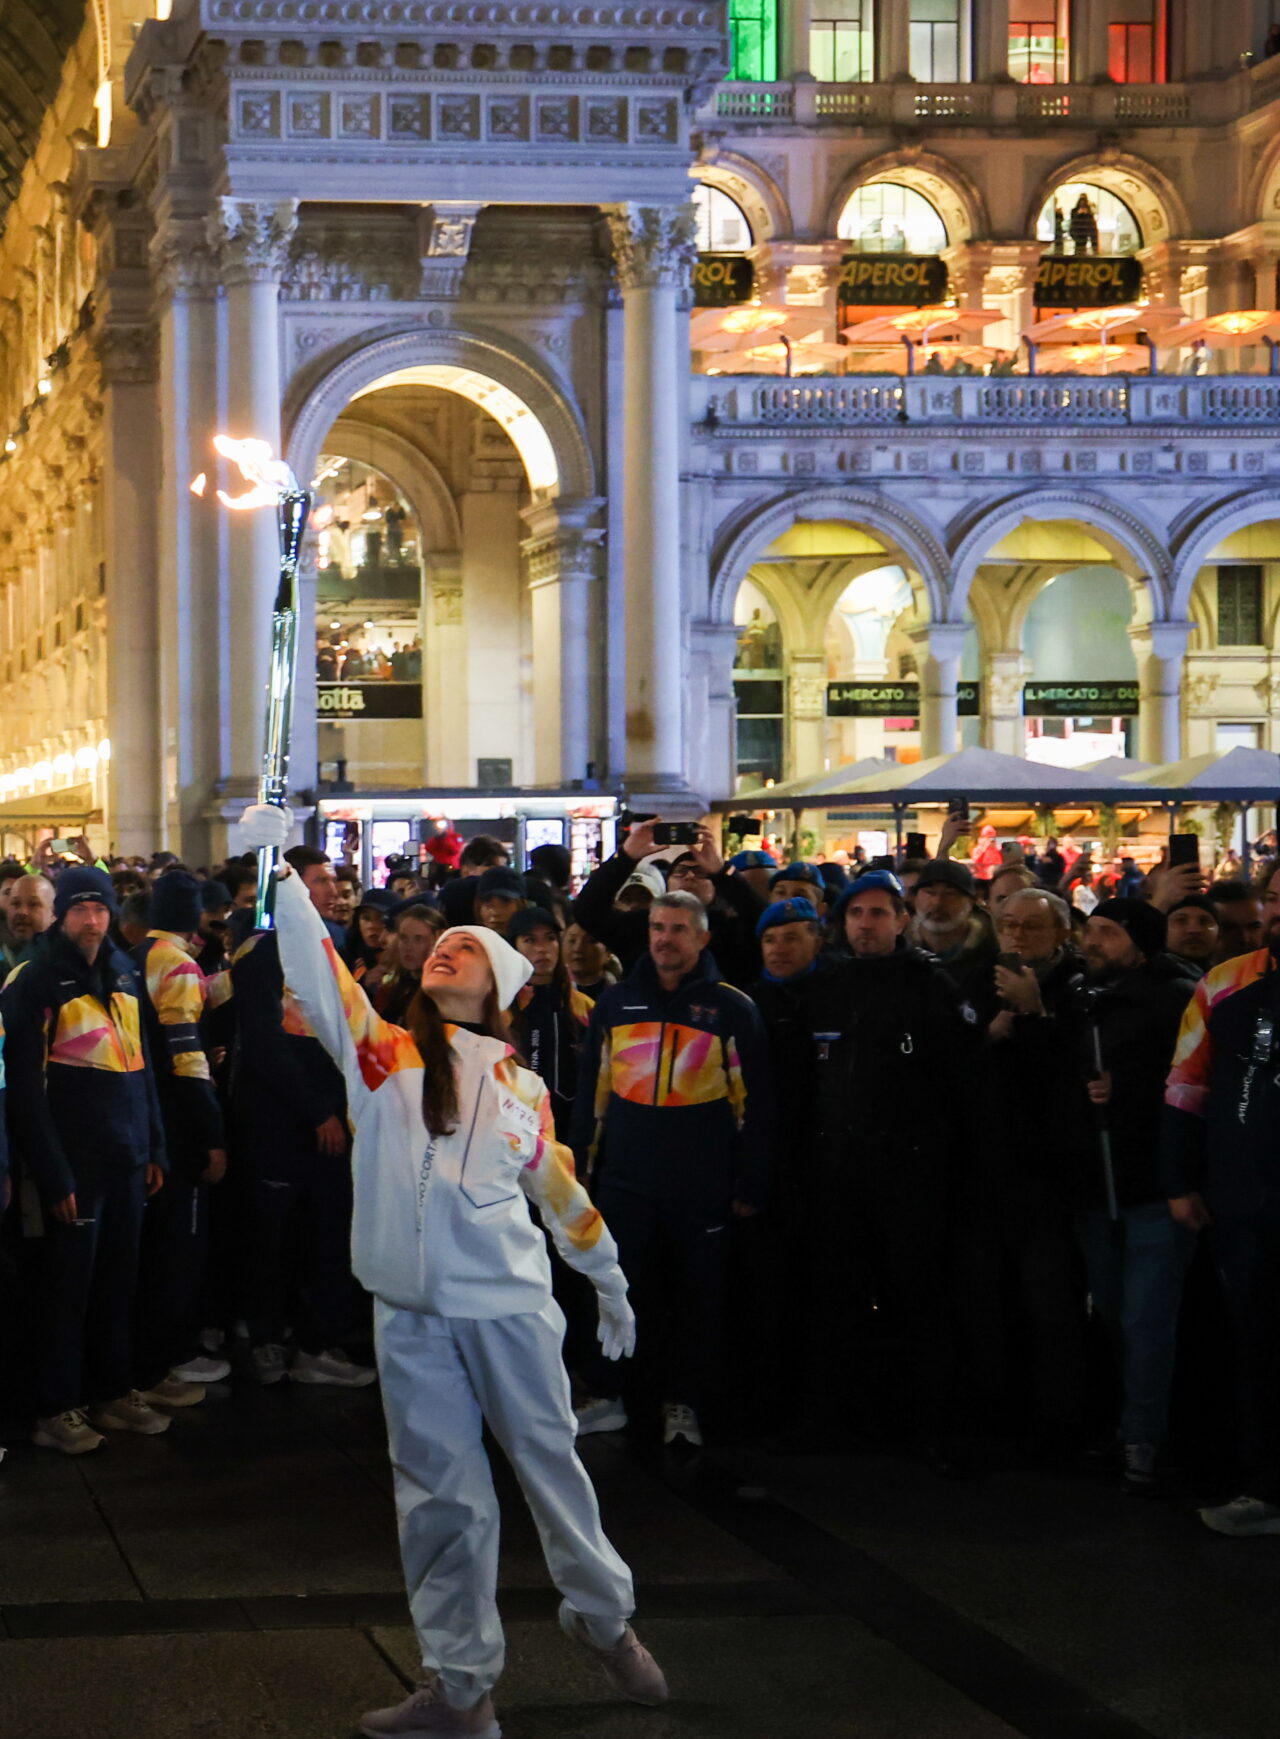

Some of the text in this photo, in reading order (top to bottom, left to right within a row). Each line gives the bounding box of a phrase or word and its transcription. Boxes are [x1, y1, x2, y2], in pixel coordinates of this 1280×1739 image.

[839, 260, 930, 287] APEROL
[1033, 261, 1124, 287] APEROL
[842, 688, 904, 700] MERCATO
[1038, 688, 1099, 700] MERCATO
